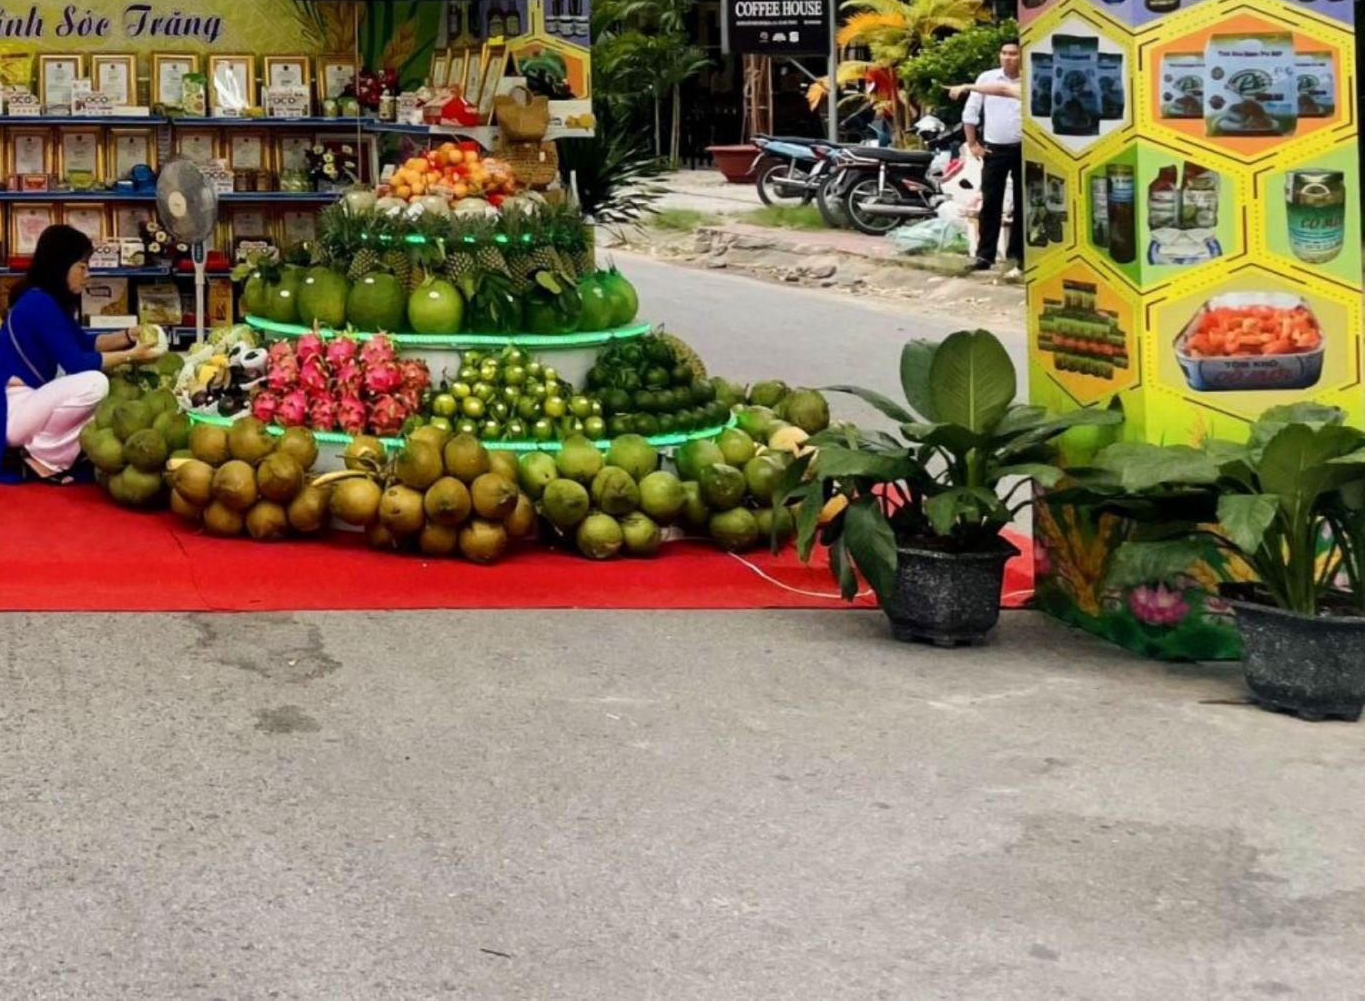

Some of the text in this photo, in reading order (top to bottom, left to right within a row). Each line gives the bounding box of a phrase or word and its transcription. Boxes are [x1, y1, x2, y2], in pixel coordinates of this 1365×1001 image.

[735, 0, 822, 17] COFFEE HOUSE
[56, 5, 109, 38] Sóc
[124, 3, 222, 44] Trăng
